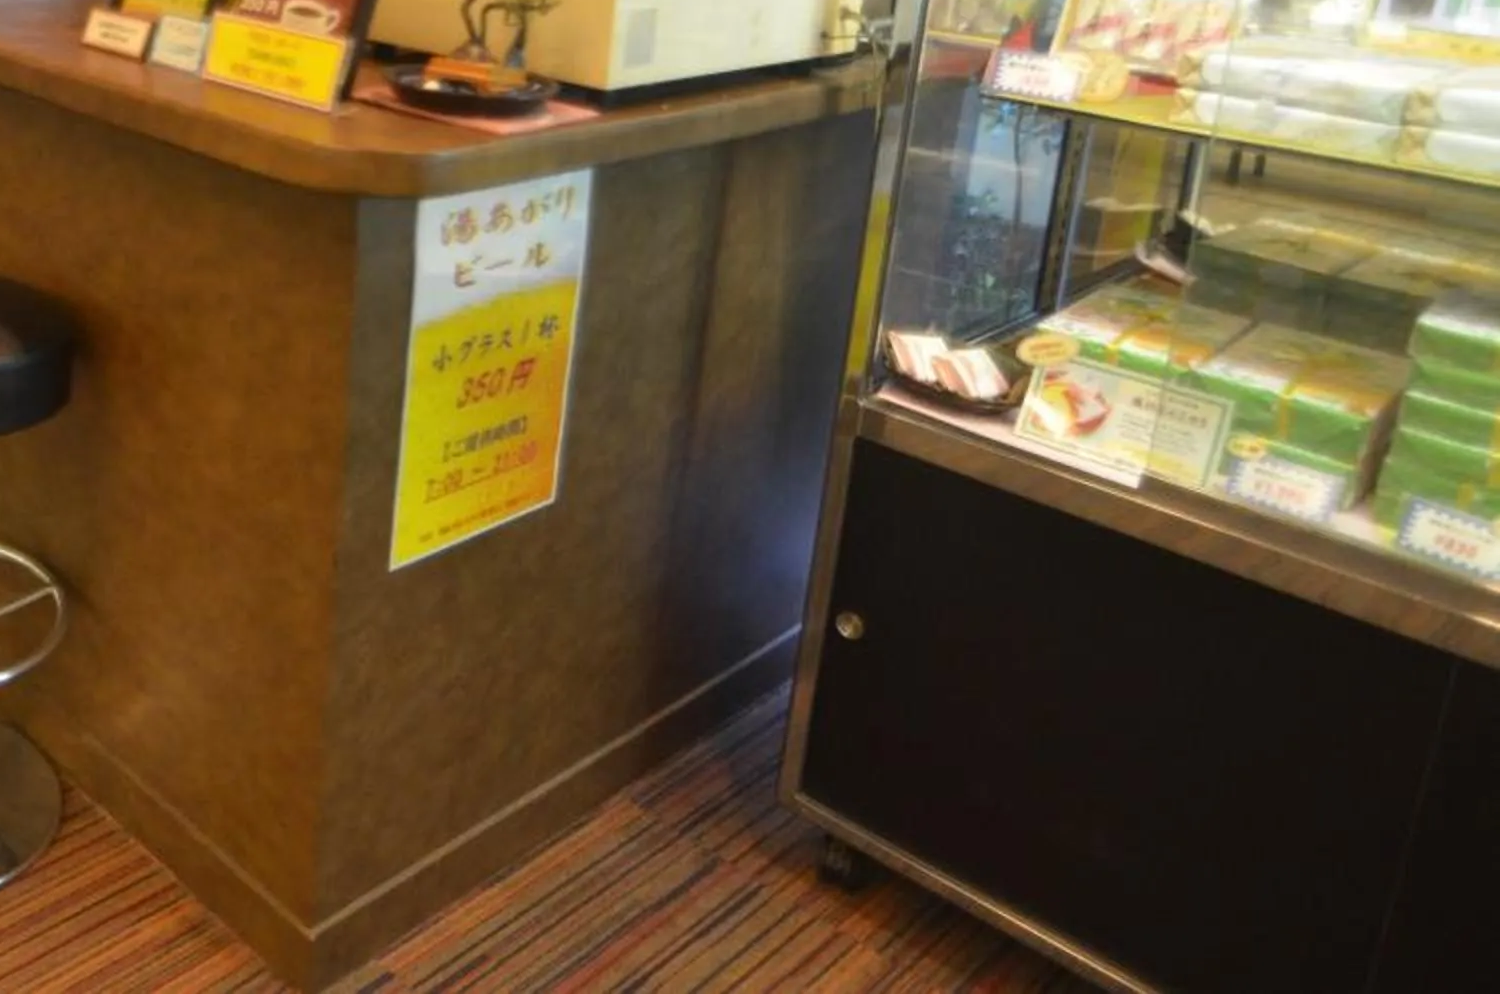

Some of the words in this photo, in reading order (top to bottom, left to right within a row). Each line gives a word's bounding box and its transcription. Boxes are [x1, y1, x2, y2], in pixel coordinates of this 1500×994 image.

[440, 184, 578, 248] 湯あがり
[453, 241, 551, 289] ビール
[455, 356, 537, 410] 350円
